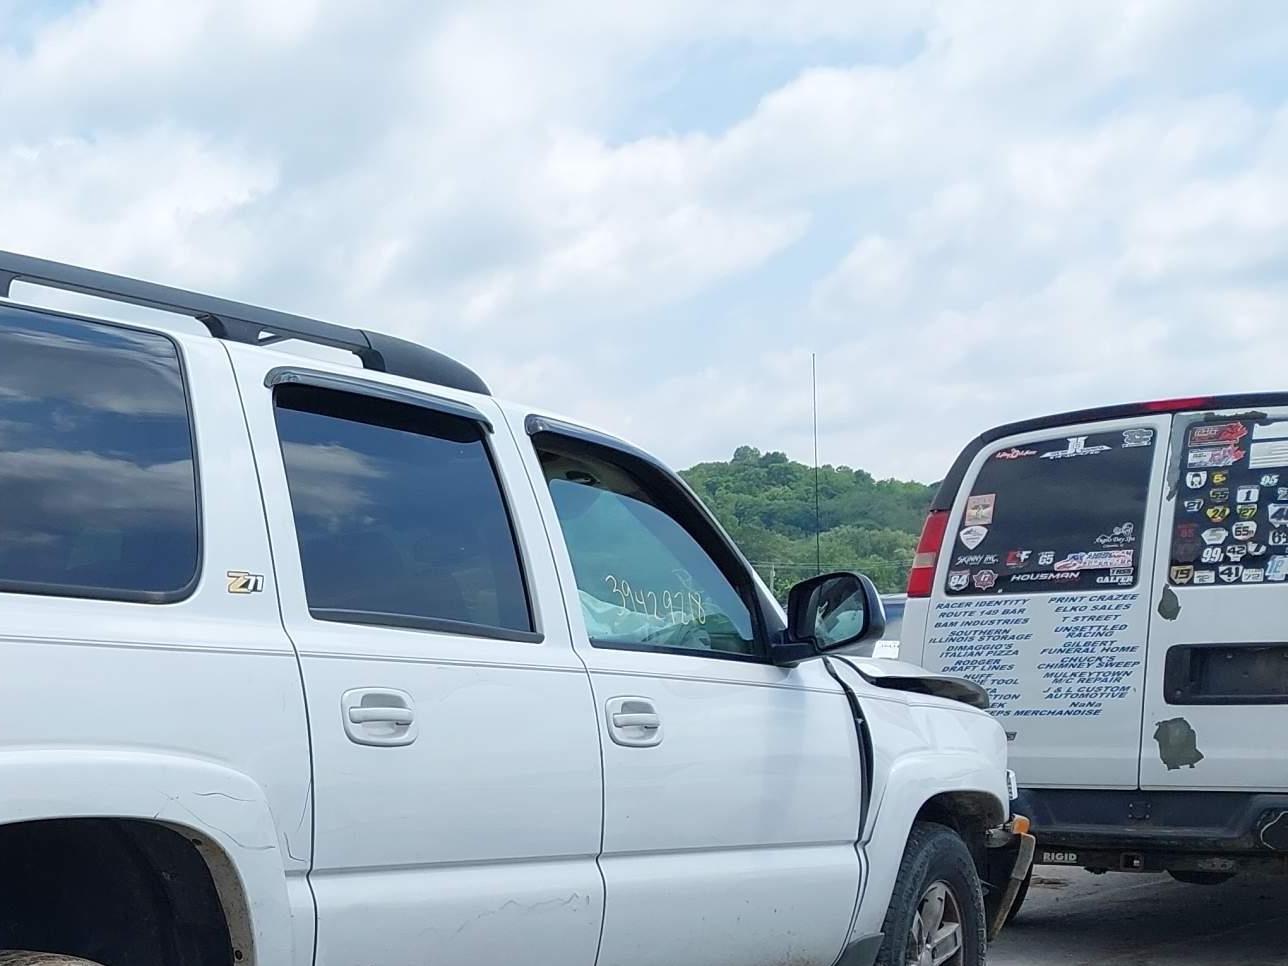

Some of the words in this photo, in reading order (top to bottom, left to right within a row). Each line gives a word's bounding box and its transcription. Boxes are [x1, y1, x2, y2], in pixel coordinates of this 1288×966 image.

[1219, 566, 1239, 577] 41
[1010, 571, 1081, 582] HOUSMAN
[1089, 594, 1140, 602] CRAZEE
[975, 599, 1031, 608] IDENTITY
[1090, 603, 1132, 611] SALES
[938, 610, 976, 618] ROUTE
[979, 609, 999, 617] 149
[960, 617, 1030, 627] INDUSTRIES
[1072, 614, 1121, 622] STREET
[948, 628, 1011, 636] SOUTHERN
[1054, 624, 1128, 632] UNSETTLED
[929, 635, 975, 644] ILLINOIS
[978, 633, 1033, 642] STORAGE
[946, 643, 1013, 651] DIMAGGIO'S
[1063, 640, 1118, 648] GILBERT
[939, 650, 983, 658] ITALIAN
[1040, 647, 1097, 655] FUNERAL
[1100, 645, 1140, 653] HOME
[1060, 655, 1116, 663] CHUCK'S
[941, 665, 978, 673] DRAFT
[981, 663, 1016, 671] LINES
[1037, 662, 1093, 670] CHIMNEY
[1095, 661, 1141, 669] SWEEP
[1043, 670, 1133, 678] MULKEYTOWN
[991, 678, 1019, 686] TOOL
[1077, 676, 1123, 684] REPAIR
[1013, 709, 1102, 717] MERCHANDISE
[1043, 852, 1077, 861] RIGID
